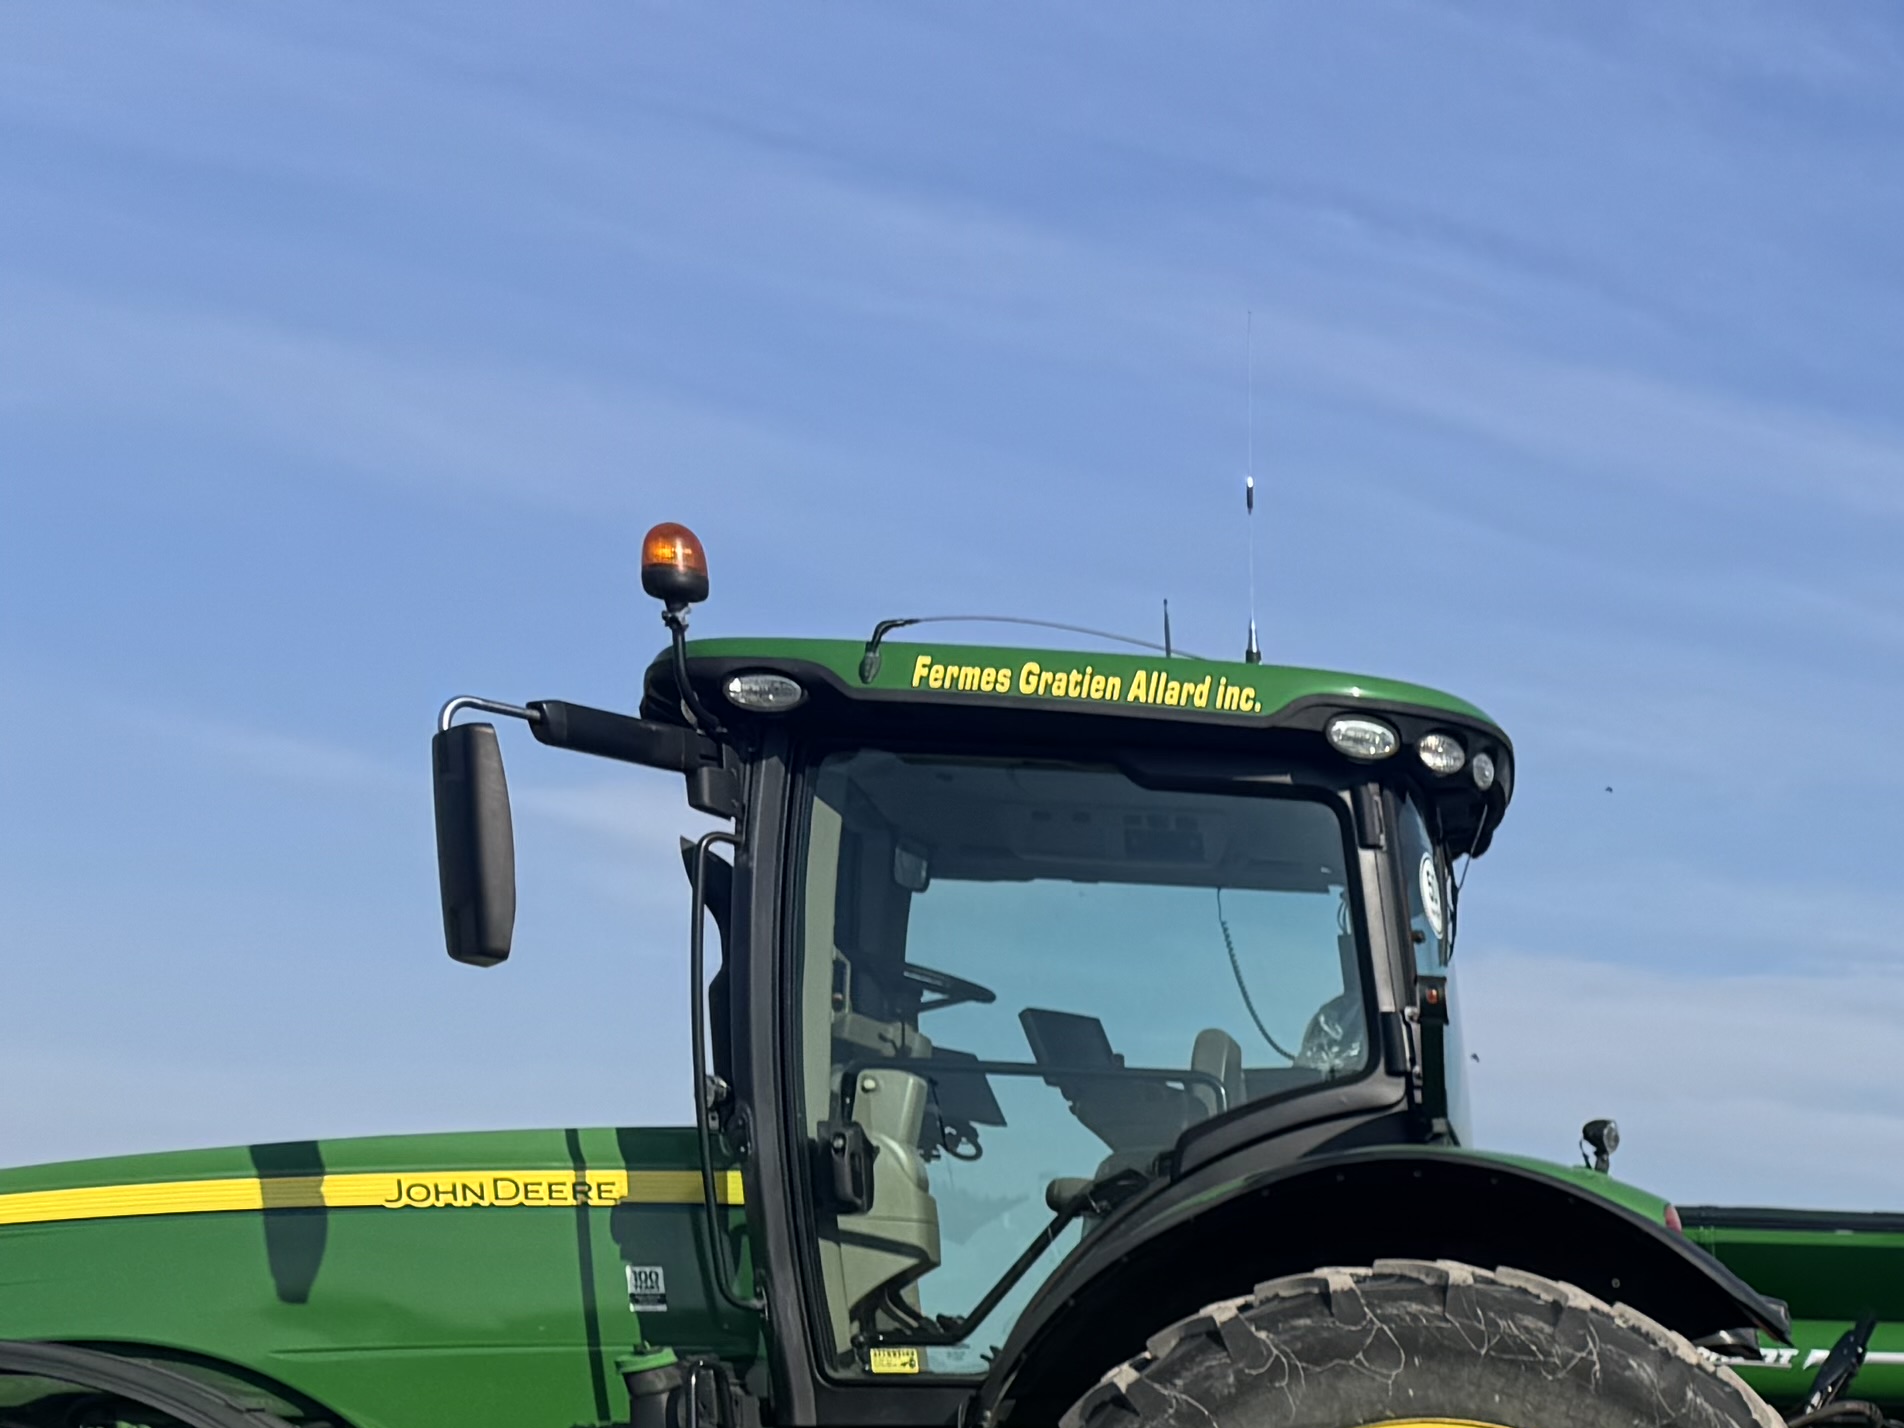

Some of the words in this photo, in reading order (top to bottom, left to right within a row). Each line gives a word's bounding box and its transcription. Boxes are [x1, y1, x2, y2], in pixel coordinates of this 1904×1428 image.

[911, 654, 1012, 694] Fermes
[1019, 661, 1122, 701] Gratien
[1126, 669, 1213, 708] Allard
[1214, 675, 1263, 714] inc.
[384, 1177, 486, 1203] JOHN
[492, 1177, 617, 1202] DEERE
